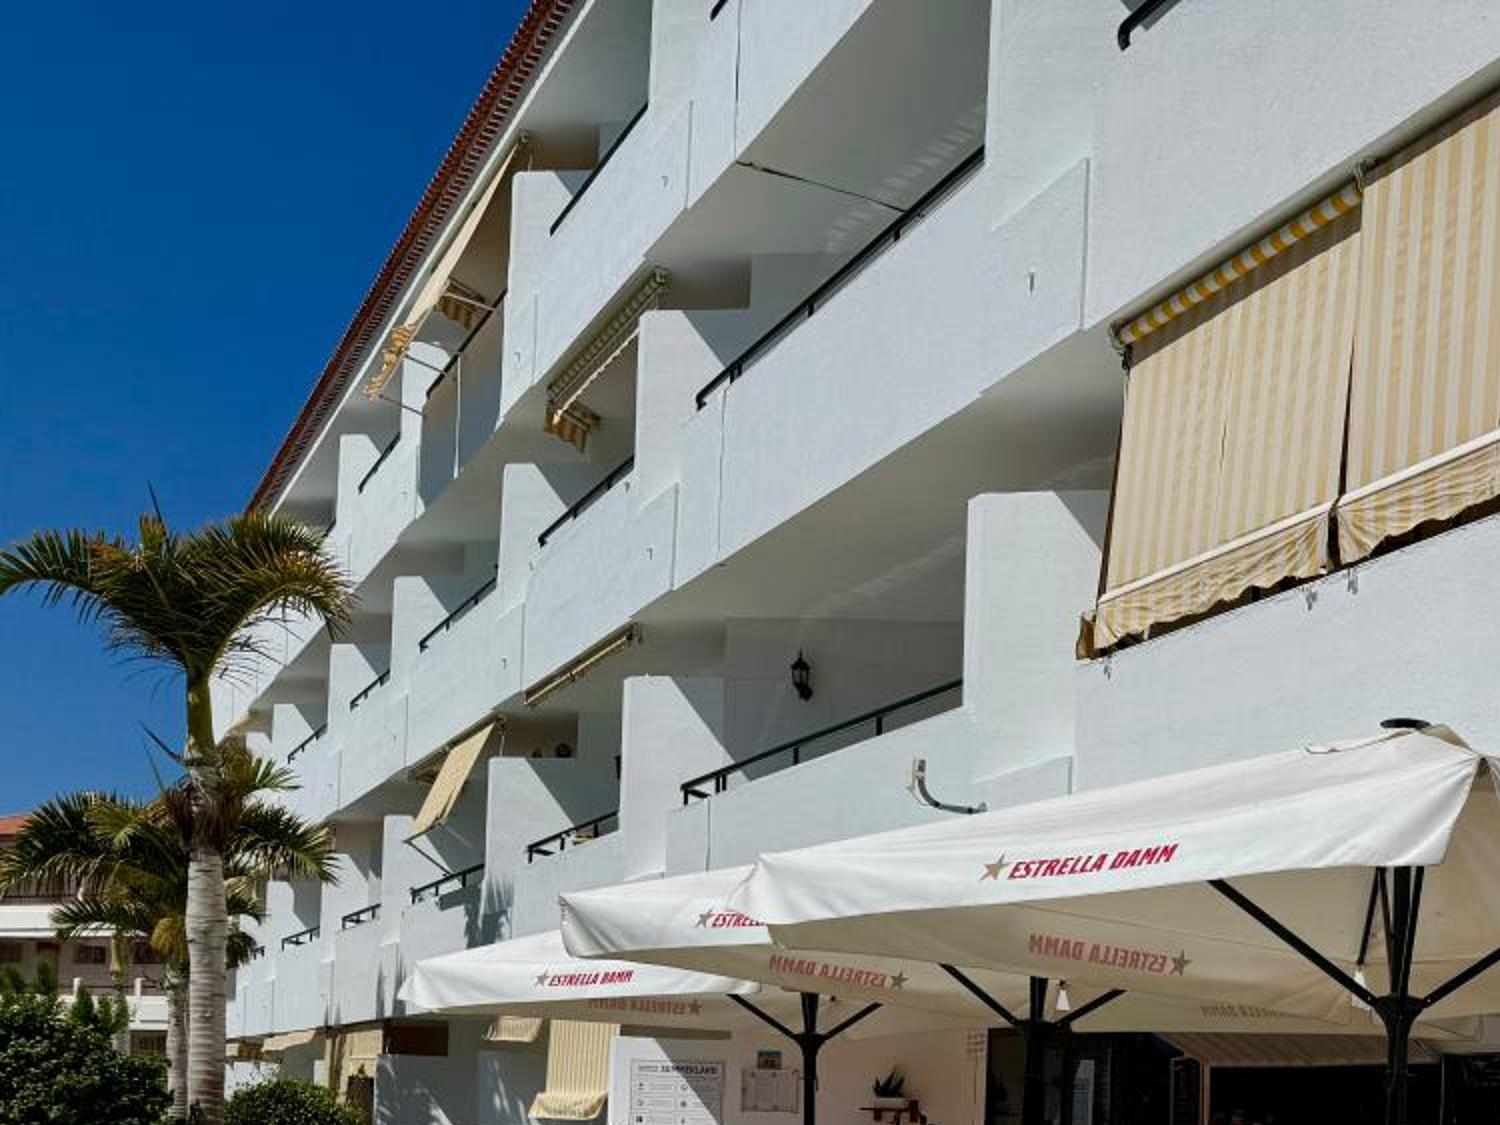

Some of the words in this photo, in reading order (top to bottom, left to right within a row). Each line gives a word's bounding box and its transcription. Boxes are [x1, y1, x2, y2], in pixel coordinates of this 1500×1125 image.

[1008, 853, 1108, 880] ESTRELLA
[1110, 843, 1179, 870] DAMM
[548, 972, 598, 987] ESTRELLA
[600, 970, 634, 985] DAMM
